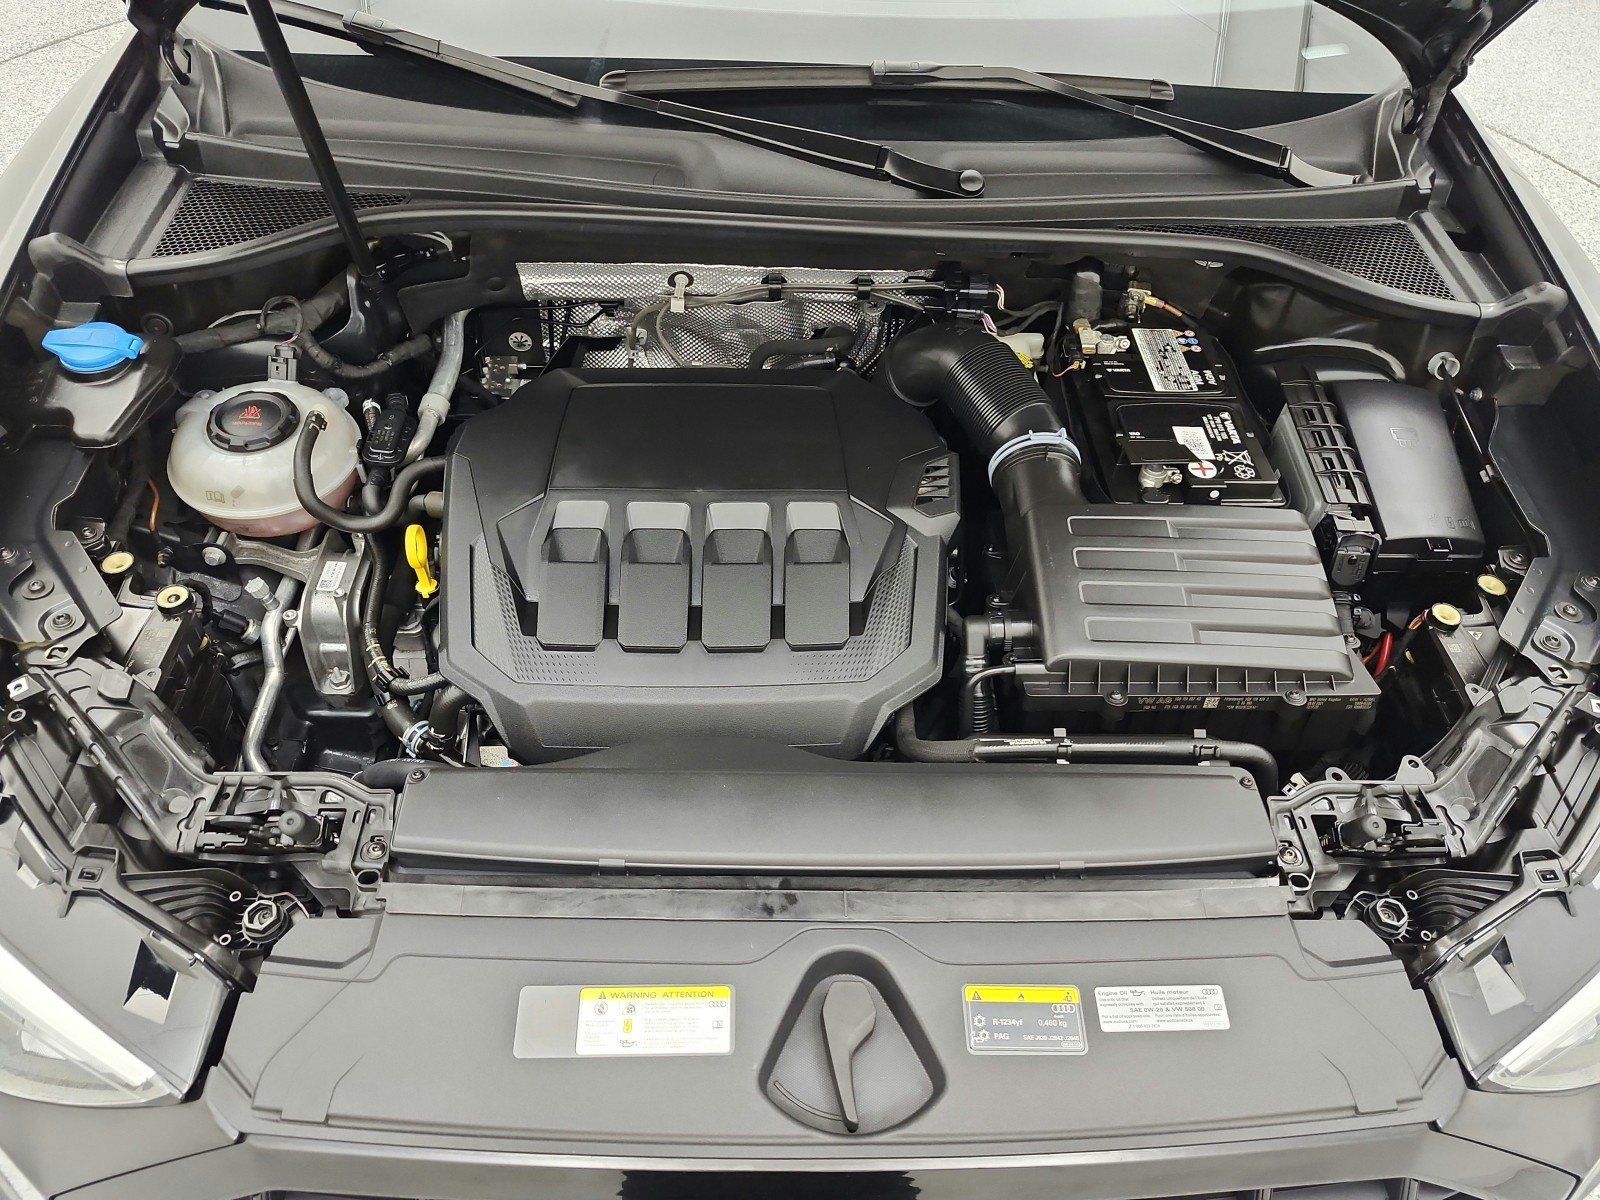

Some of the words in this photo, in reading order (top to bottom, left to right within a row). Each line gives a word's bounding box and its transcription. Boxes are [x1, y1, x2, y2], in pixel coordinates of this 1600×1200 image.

[1190, 370, 1204, 385] AGM
[1203, 370, 1217, 385] AGM
[1224, 420, 1242, 444] VARTA
[992, 1018, 1023, 1027] R-1234yf
